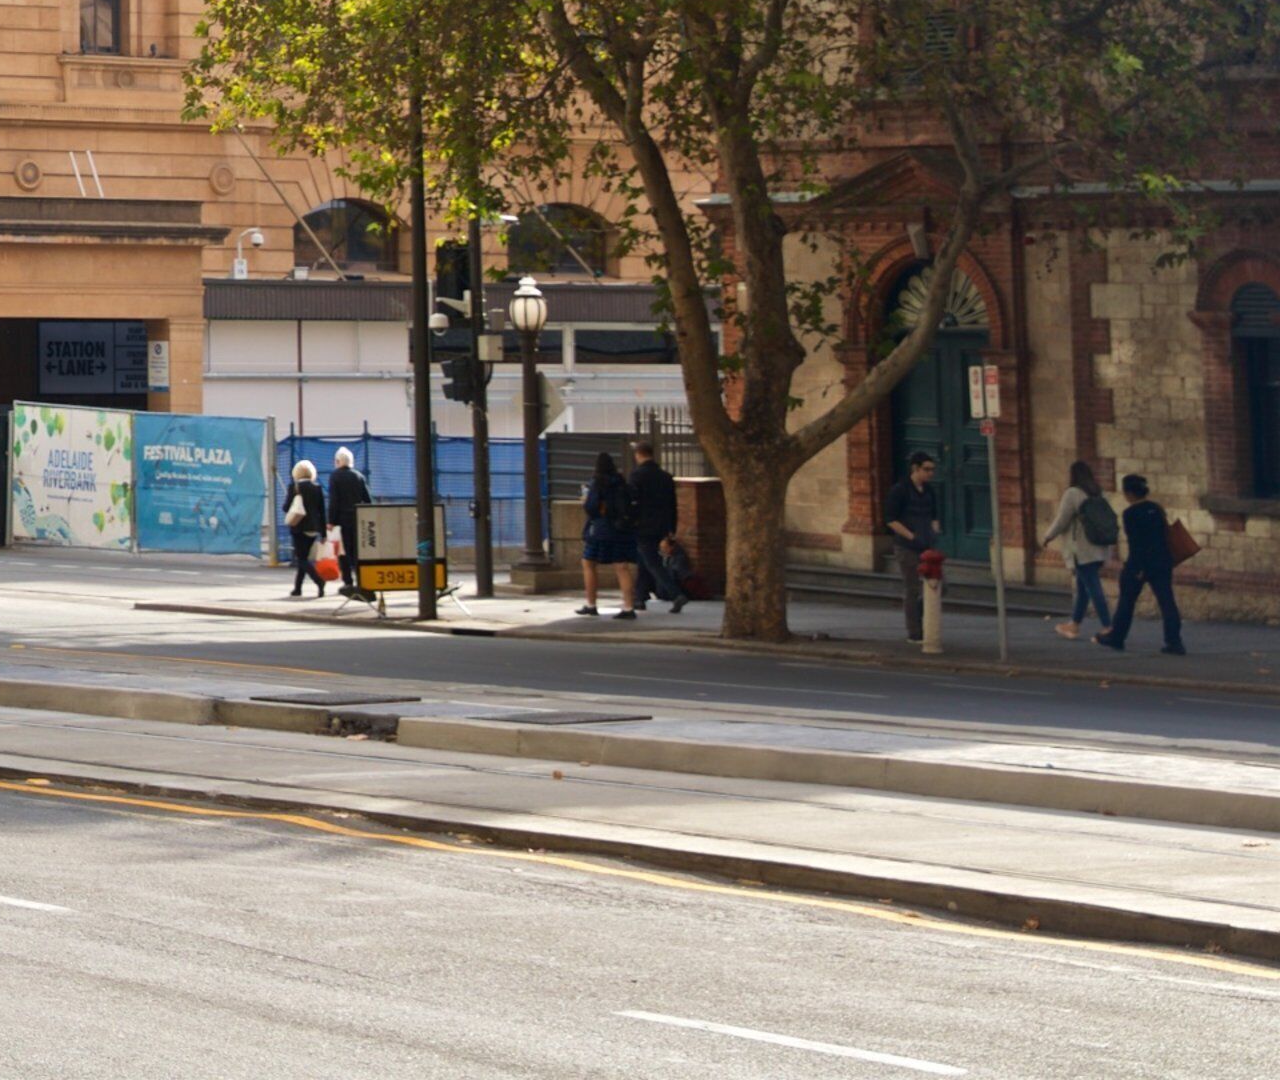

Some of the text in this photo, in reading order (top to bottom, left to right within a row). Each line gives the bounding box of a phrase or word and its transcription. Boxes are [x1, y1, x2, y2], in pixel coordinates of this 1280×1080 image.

[46, 341, 106, 358] STATION
[58, 359, 95, 376] LANE
[47, 449, 94, 472] ADELAIDE
[143, 444, 233, 465] FESTIVAL PLAZA
[42, 468, 97, 493] RIVERBANK
